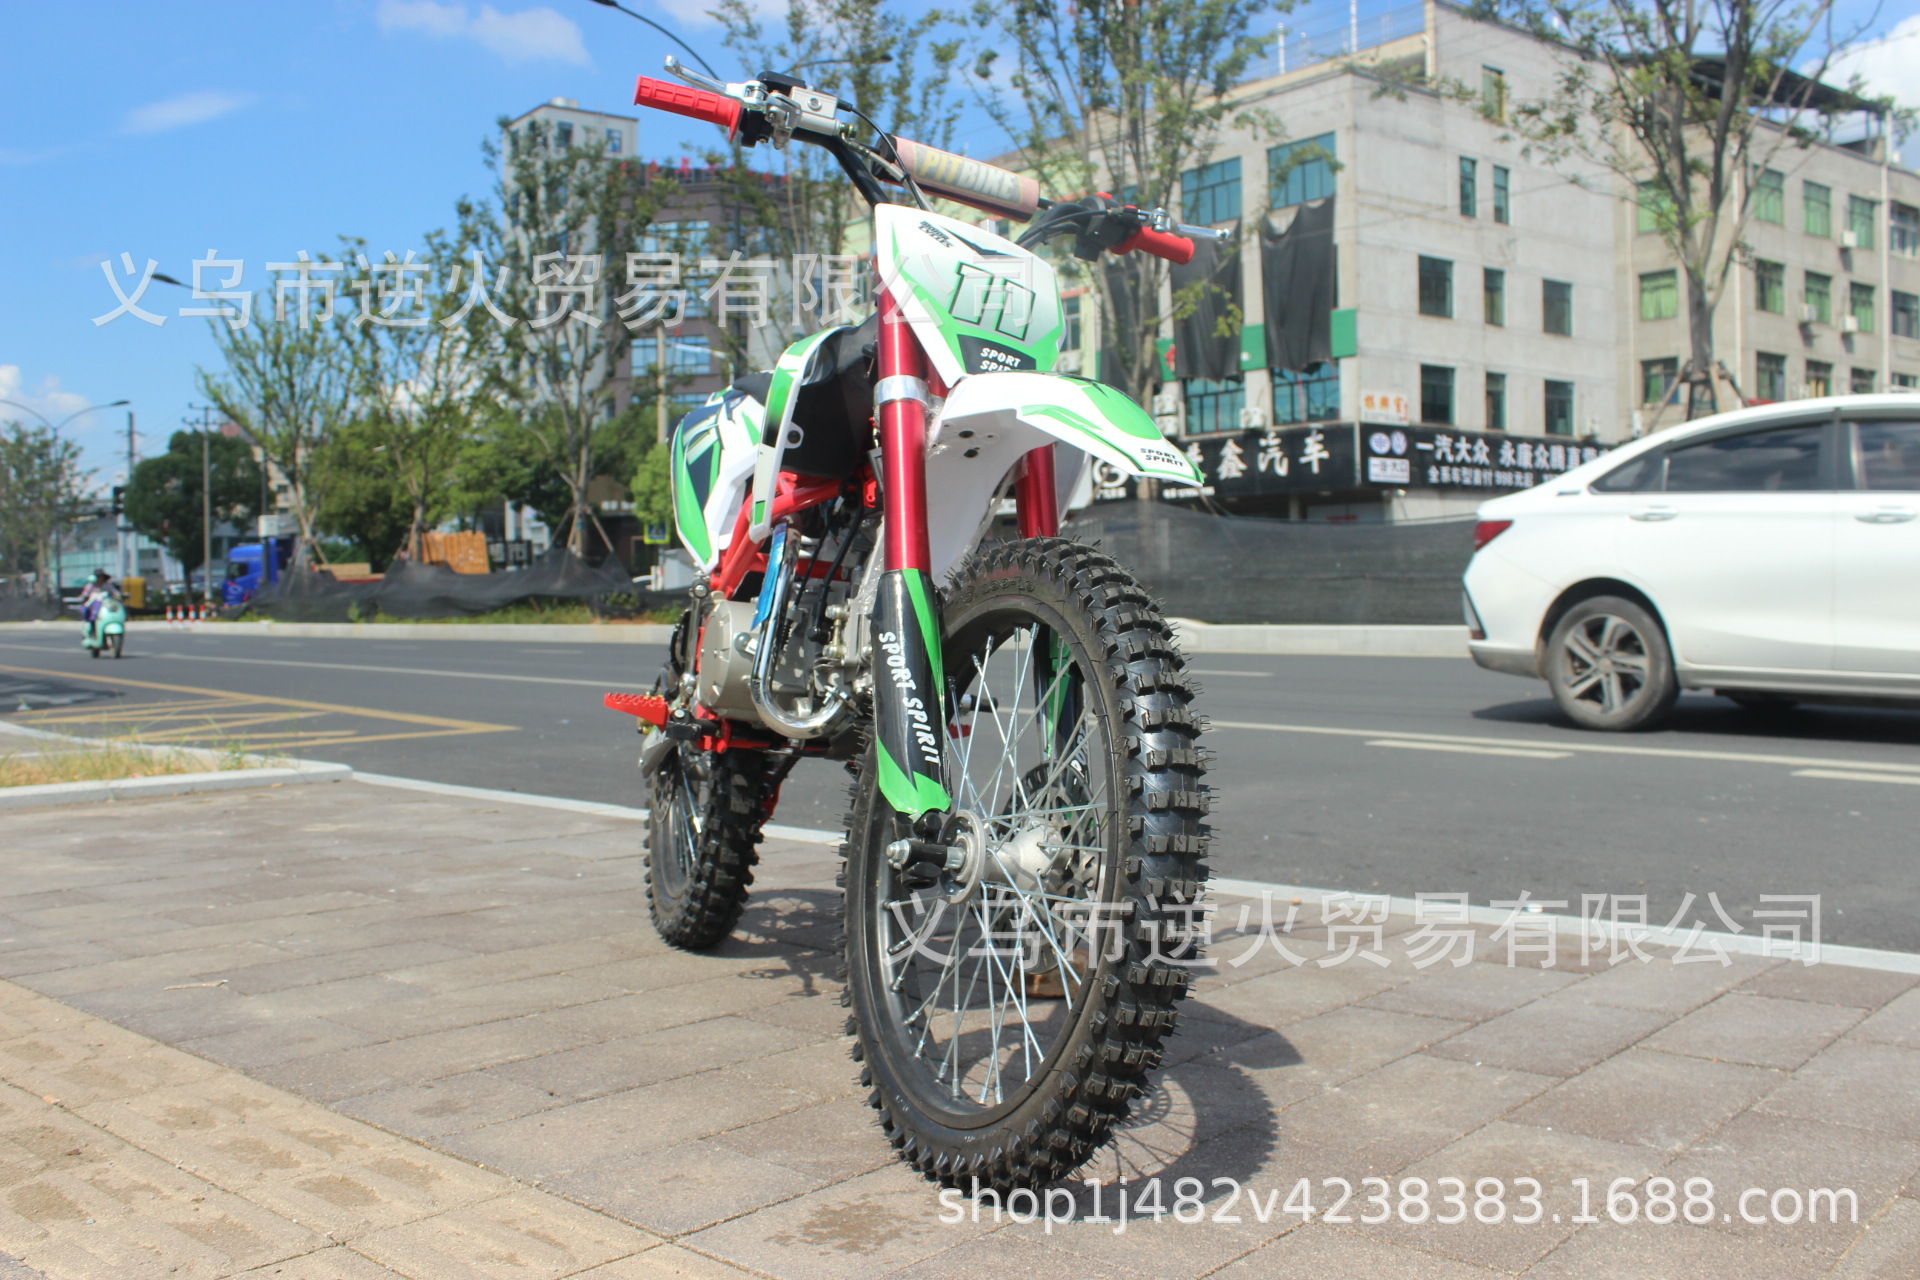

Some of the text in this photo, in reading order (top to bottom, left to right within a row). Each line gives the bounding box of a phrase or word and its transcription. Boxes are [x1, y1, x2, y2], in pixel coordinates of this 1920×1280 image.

[979, 346, 1022, 369] SPORT
[979, 359, 1013, 373] SPIR
[1150, 447, 1186, 460] SPORT
[1155, 454, 1194, 467] SPIRIT
[1416, 433, 1602, 472] 一汽大众 永康众腾直营
[878, 631, 941, 765] SPORT SPIRIT
